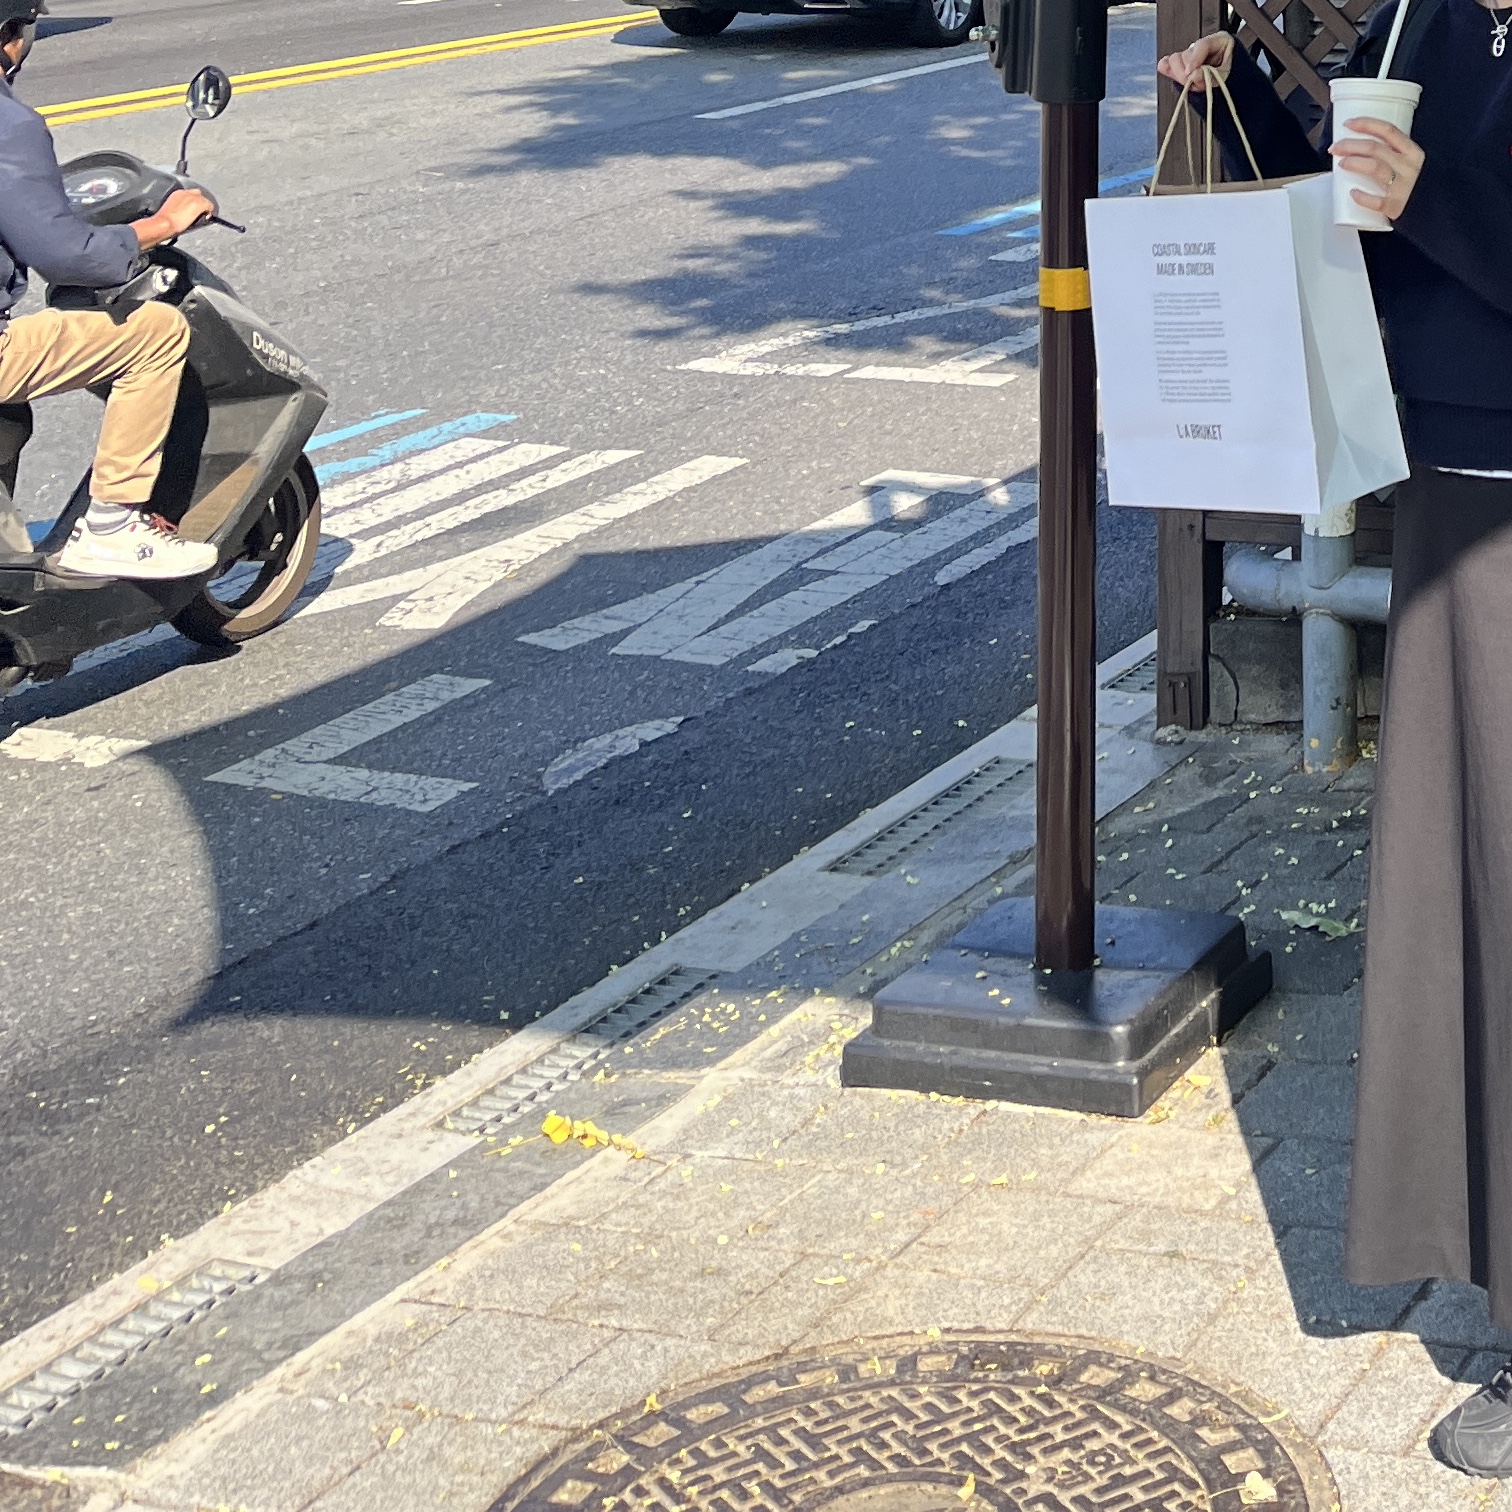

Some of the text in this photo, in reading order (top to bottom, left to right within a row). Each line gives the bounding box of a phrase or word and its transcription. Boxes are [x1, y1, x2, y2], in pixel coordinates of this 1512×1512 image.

[1152, 242, 1183, 257] COASTAL
[1156, 262, 1215, 277] MADE IN SWEDEN
[252, 331, 288, 364] Duson
